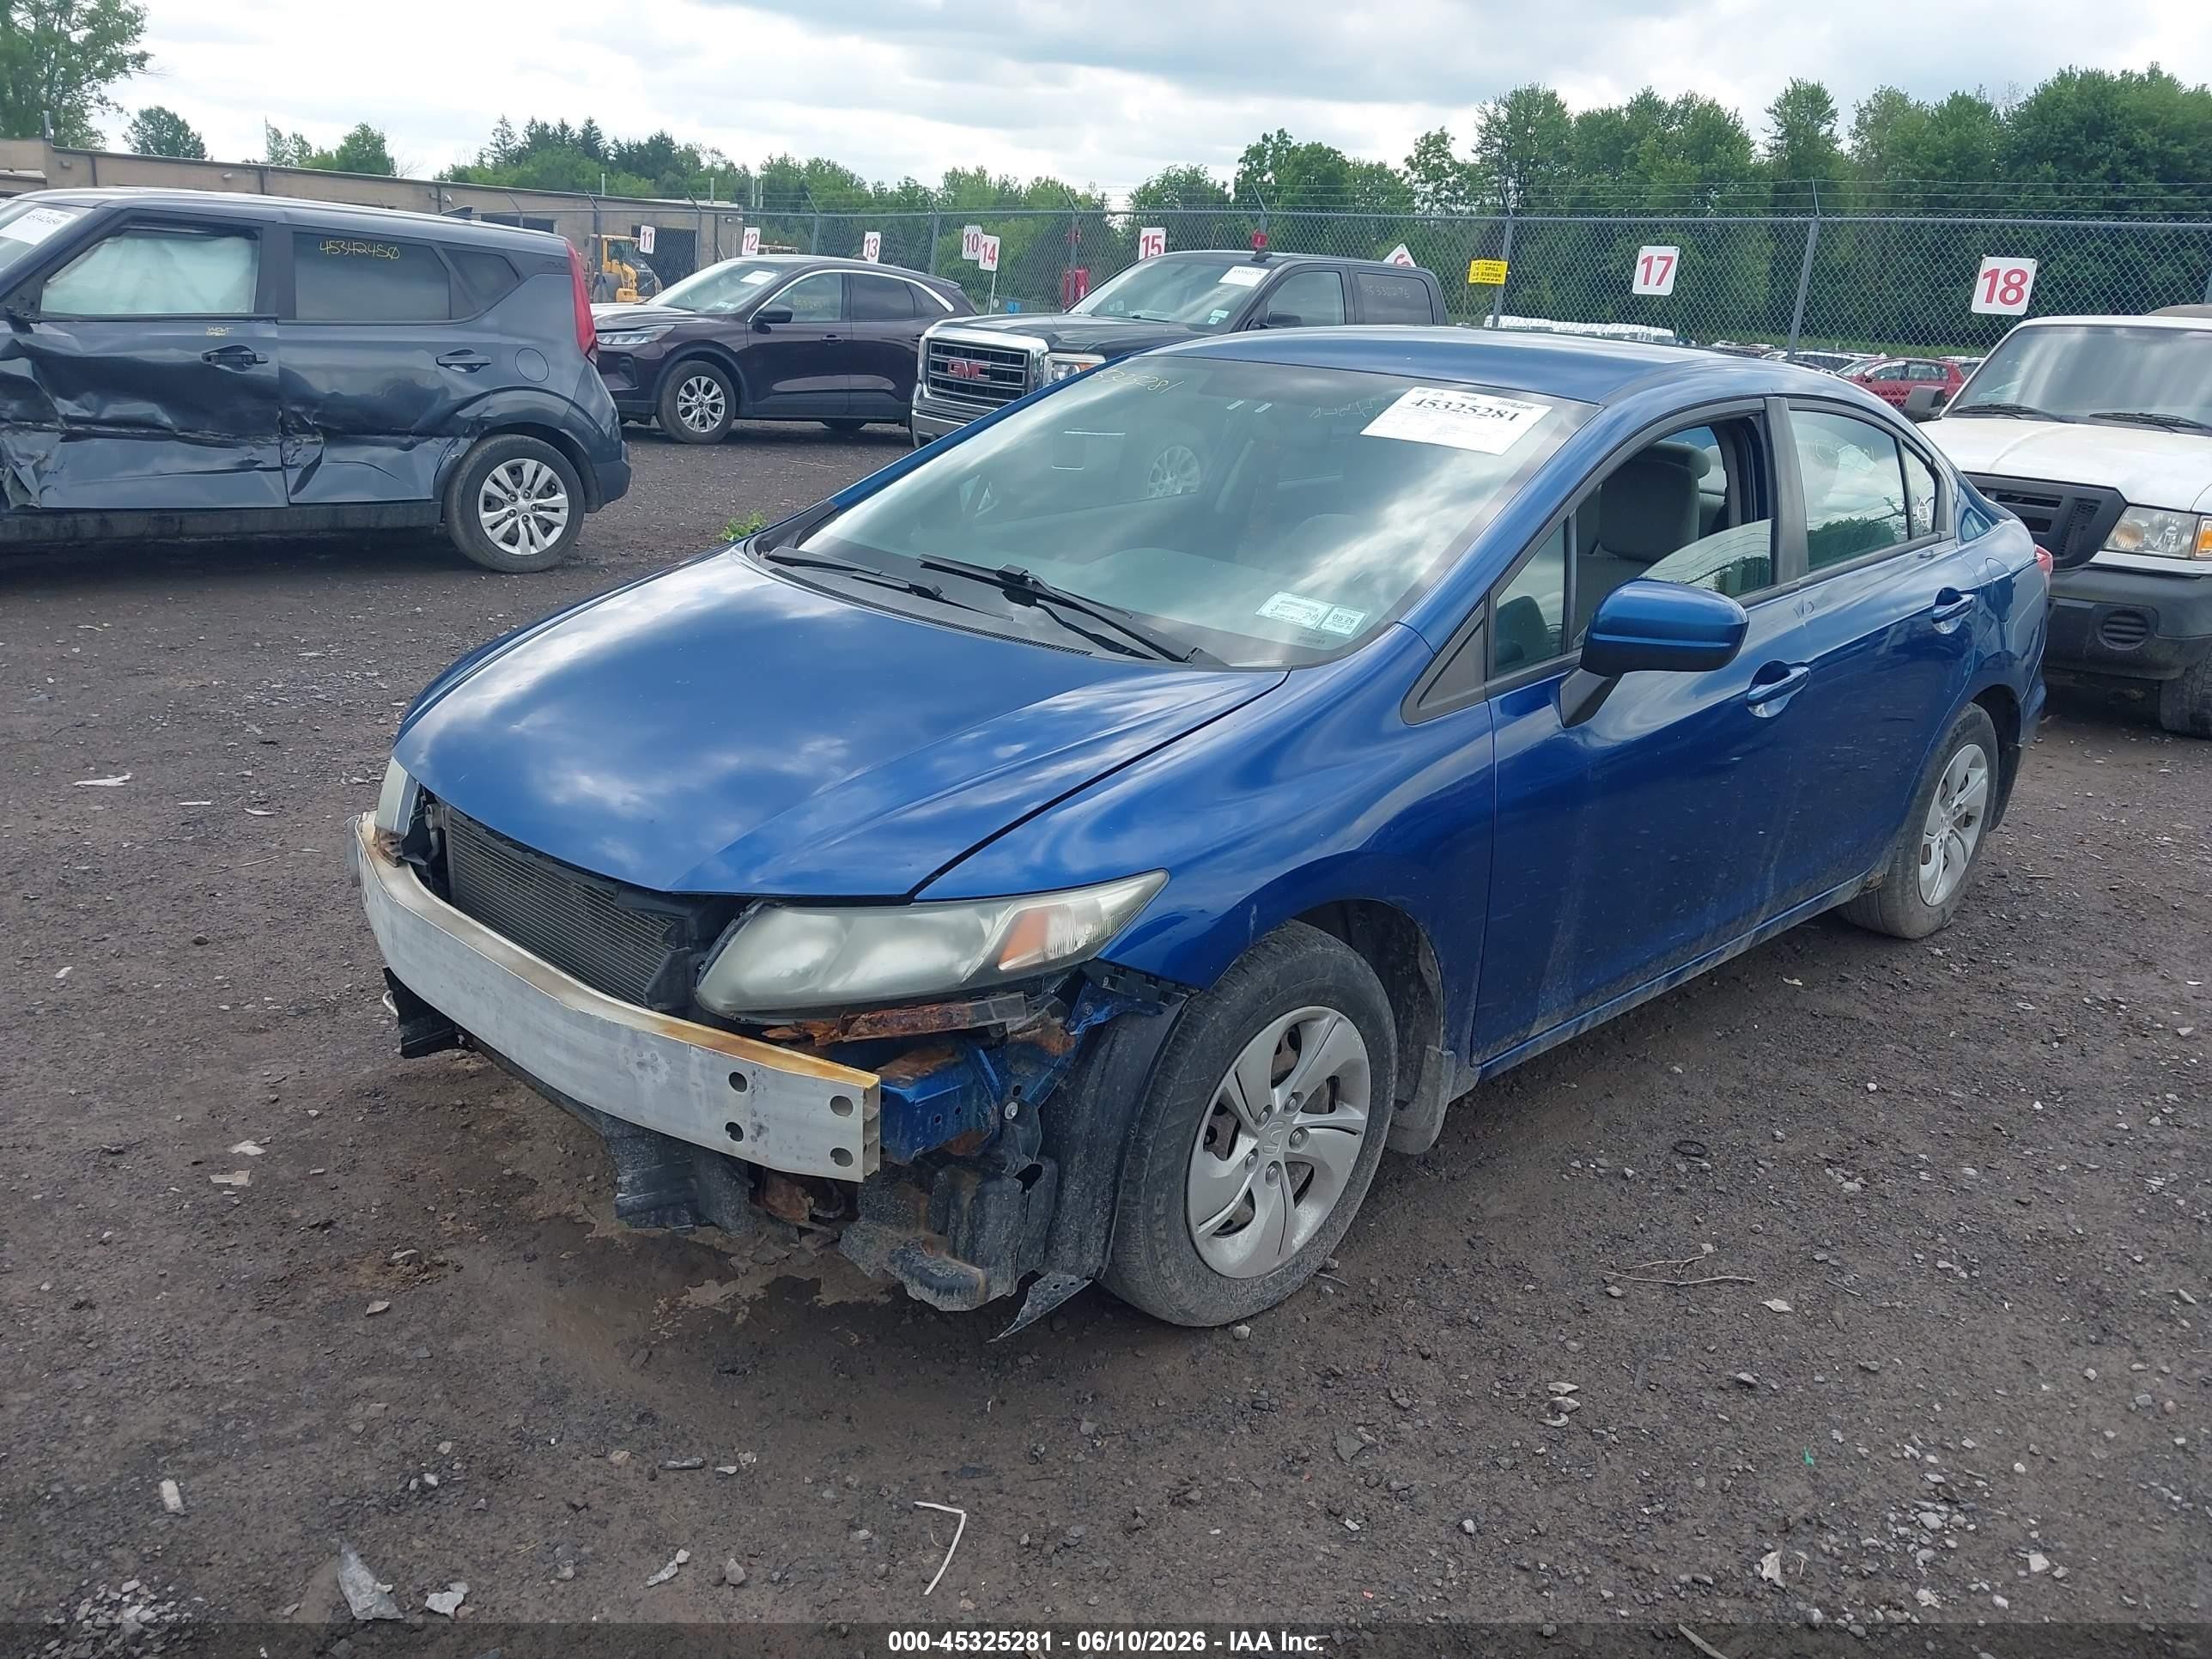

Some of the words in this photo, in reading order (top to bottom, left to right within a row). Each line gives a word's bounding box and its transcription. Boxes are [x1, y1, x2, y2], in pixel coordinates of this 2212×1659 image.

[641, 231, 653, 248] 11
[744, 234, 758, 251] 12
[865, 238, 878, 258] 13
[964, 234, 980, 253] 10
[1142, 235, 1162, 258] 15
[981, 242, 997, 264] 14
[1641, 256, 1674, 286] 17
[1982, 268, 2028, 306] 18
[948, 359, 990, 380] GMC
[1411, 397, 1521, 422] 45325281
